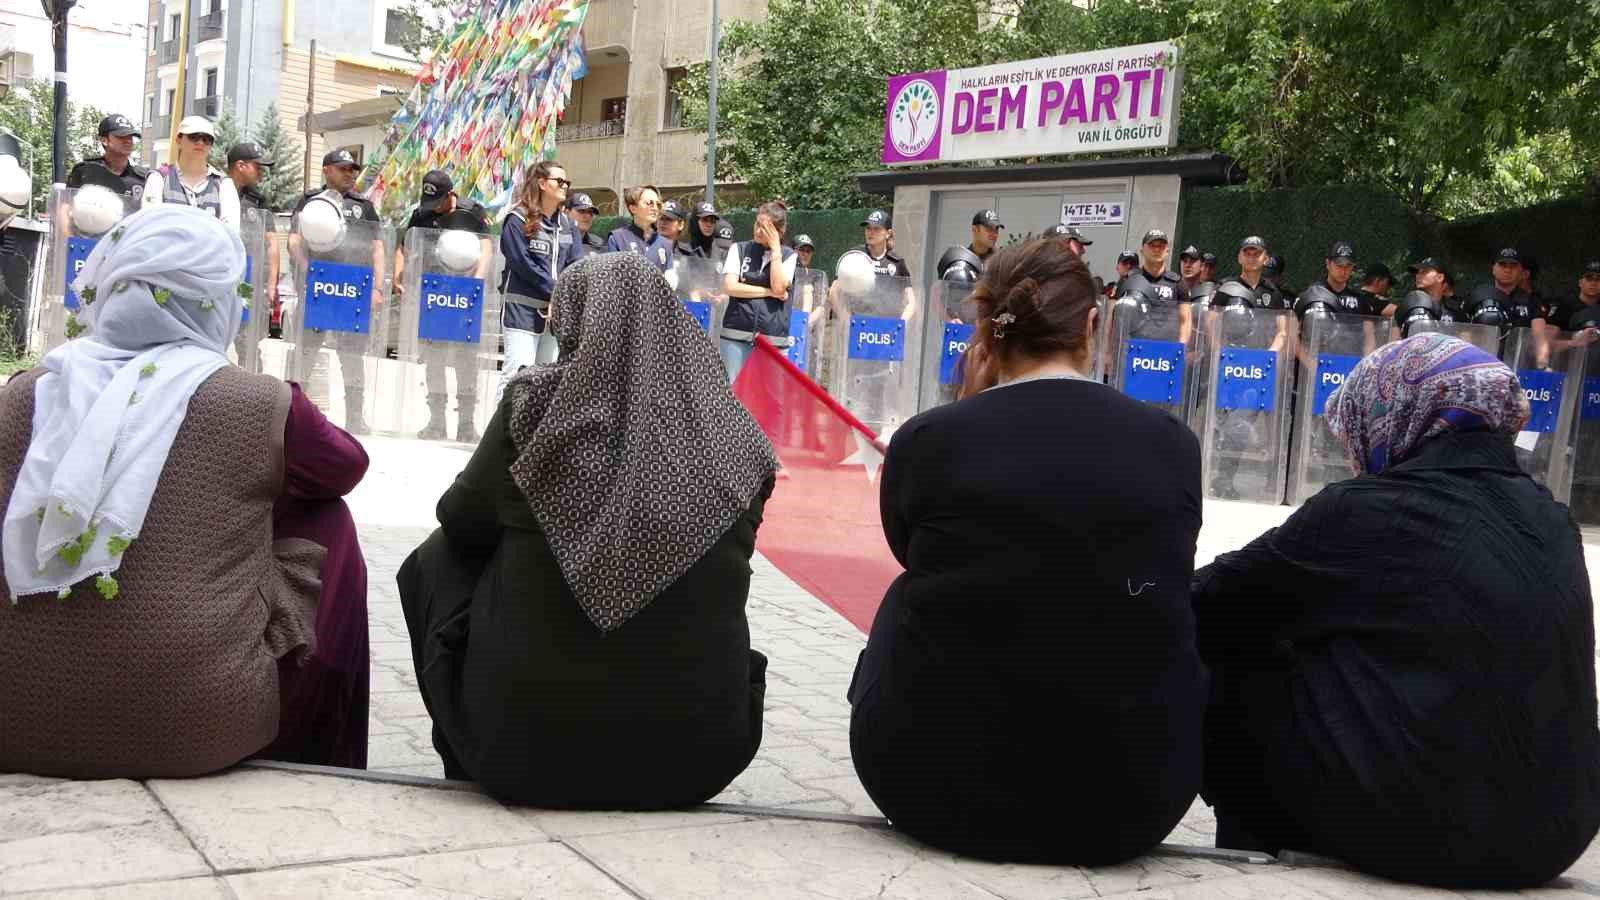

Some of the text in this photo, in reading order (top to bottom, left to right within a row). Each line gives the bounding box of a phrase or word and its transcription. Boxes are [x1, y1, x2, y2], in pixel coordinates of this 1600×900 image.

[961, 73, 1009, 89] HALKLARIN
[1010, 68, 1044, 84] EŞİTLİK
[1046, 69, 1057, 78] VE
[1059, 58, 1114, 77] DEMOKRASİ
[951, 85, 1028, 136] DEM
[1078, 123, 1162, 144] VAN İL ÖRGÜTÜ
[1095, 204, 1107, 215] 14
[314, 282, 357, 298] POLİS
[427, 293, 469, 309] POLİS
[859, 332, 891, 345] POLİS
[1133, 357, 1170, 371] POLİS
[1225, 365, 1263, 379] POLİS
